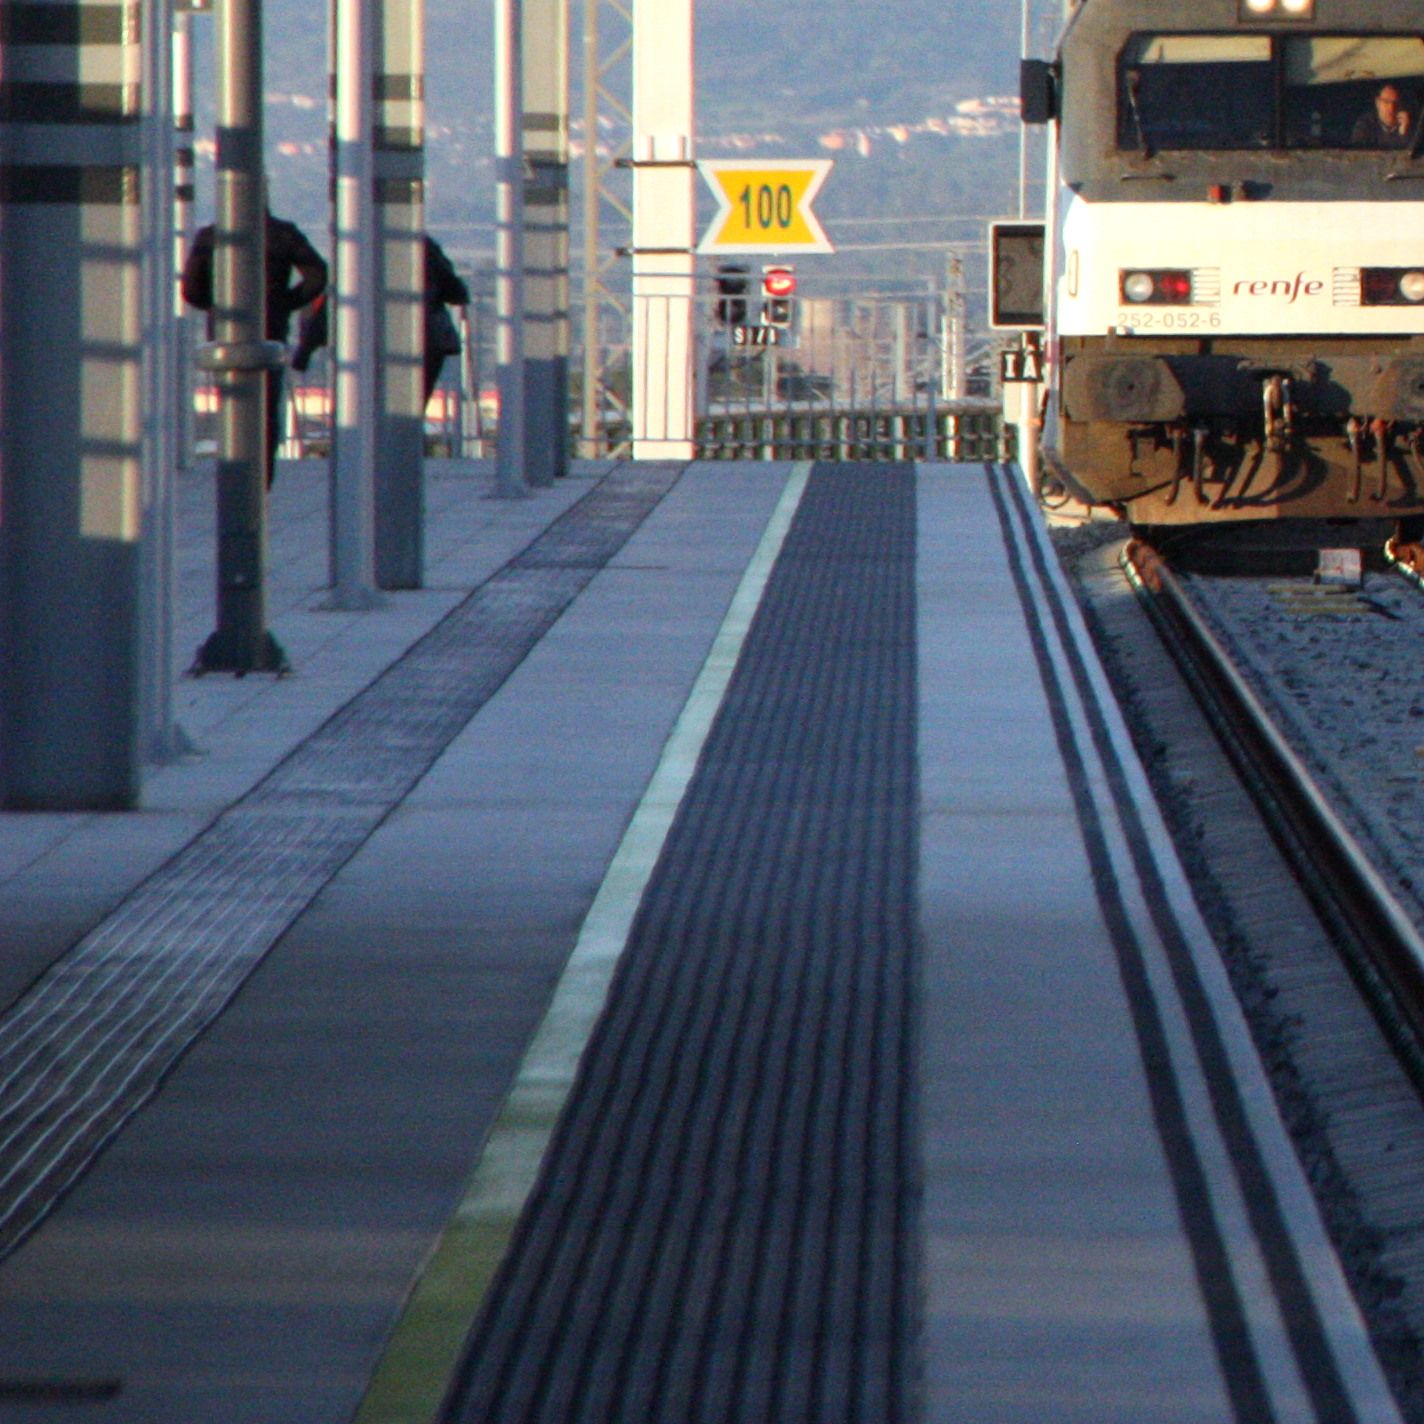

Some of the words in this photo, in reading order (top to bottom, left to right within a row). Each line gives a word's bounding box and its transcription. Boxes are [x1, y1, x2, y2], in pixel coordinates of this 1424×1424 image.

[739, 184, 793, 229] 100
[1232, 270, 1324, 304] renfe
[1117, 312, 1222, 328] 252-052-6
